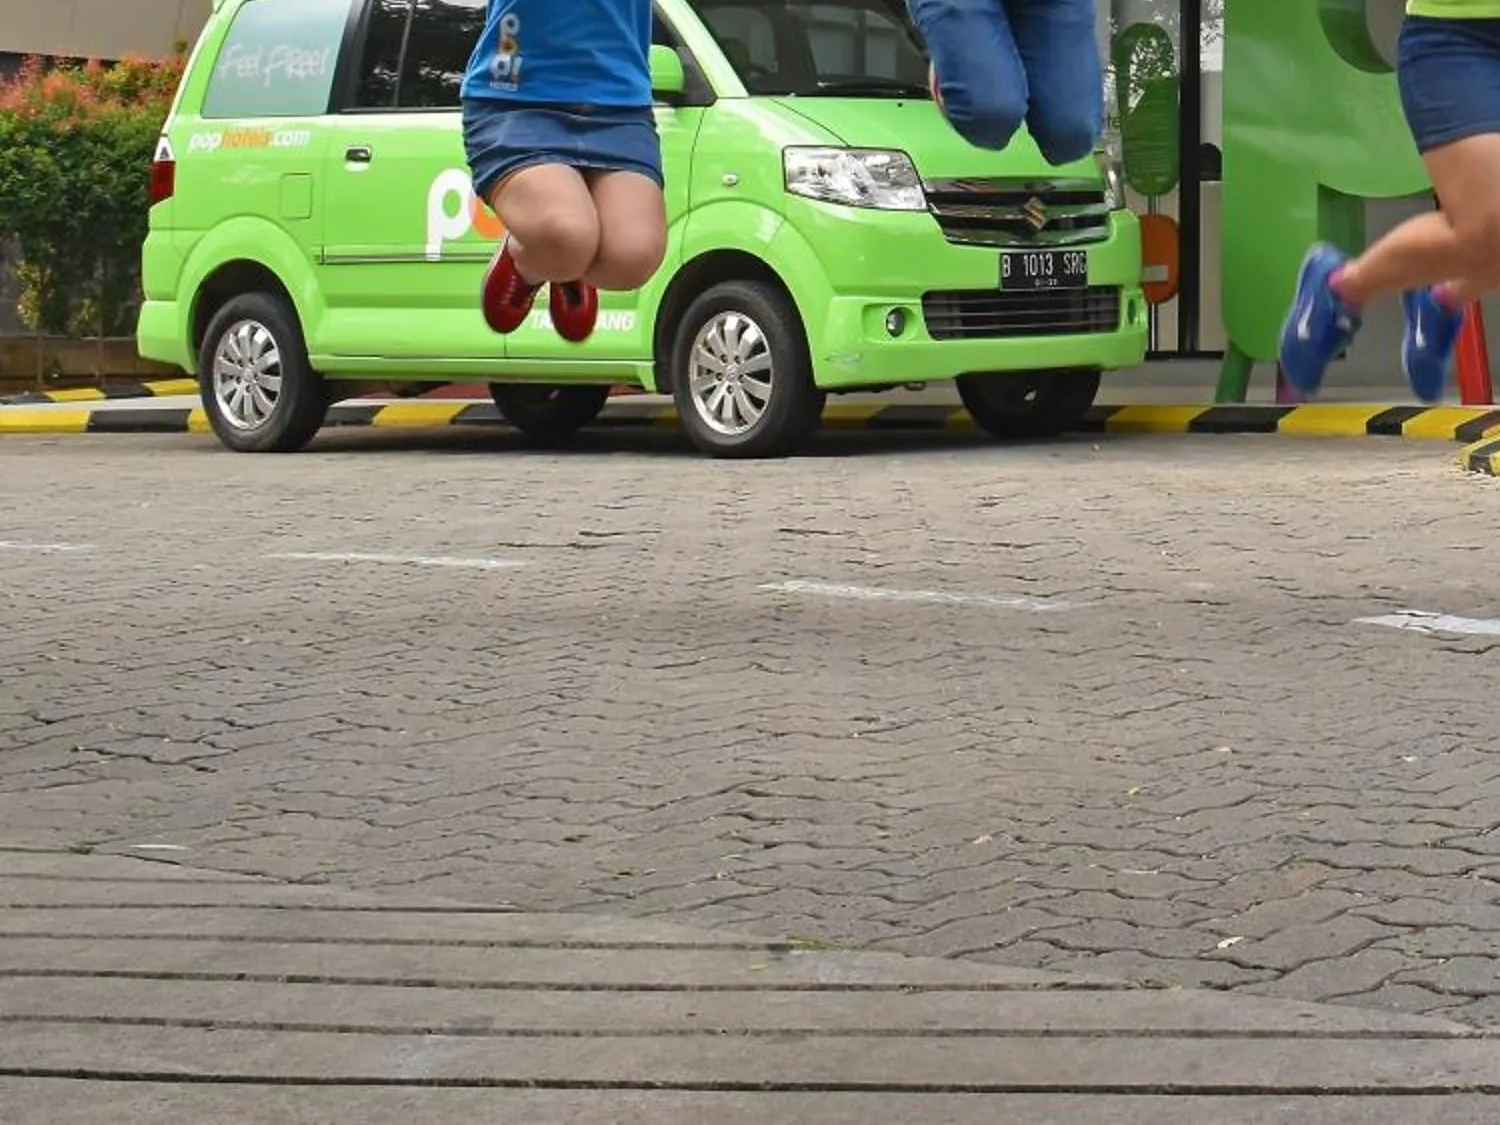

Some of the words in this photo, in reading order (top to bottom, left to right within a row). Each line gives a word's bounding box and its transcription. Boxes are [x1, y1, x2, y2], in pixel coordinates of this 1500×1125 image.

[187, 125, 312, 154] pophotels.com
[1002, 254, 1012, 278] B
[1023, 252, 1054, 277] 1013
[533, 309, 635, 332] TAANG
